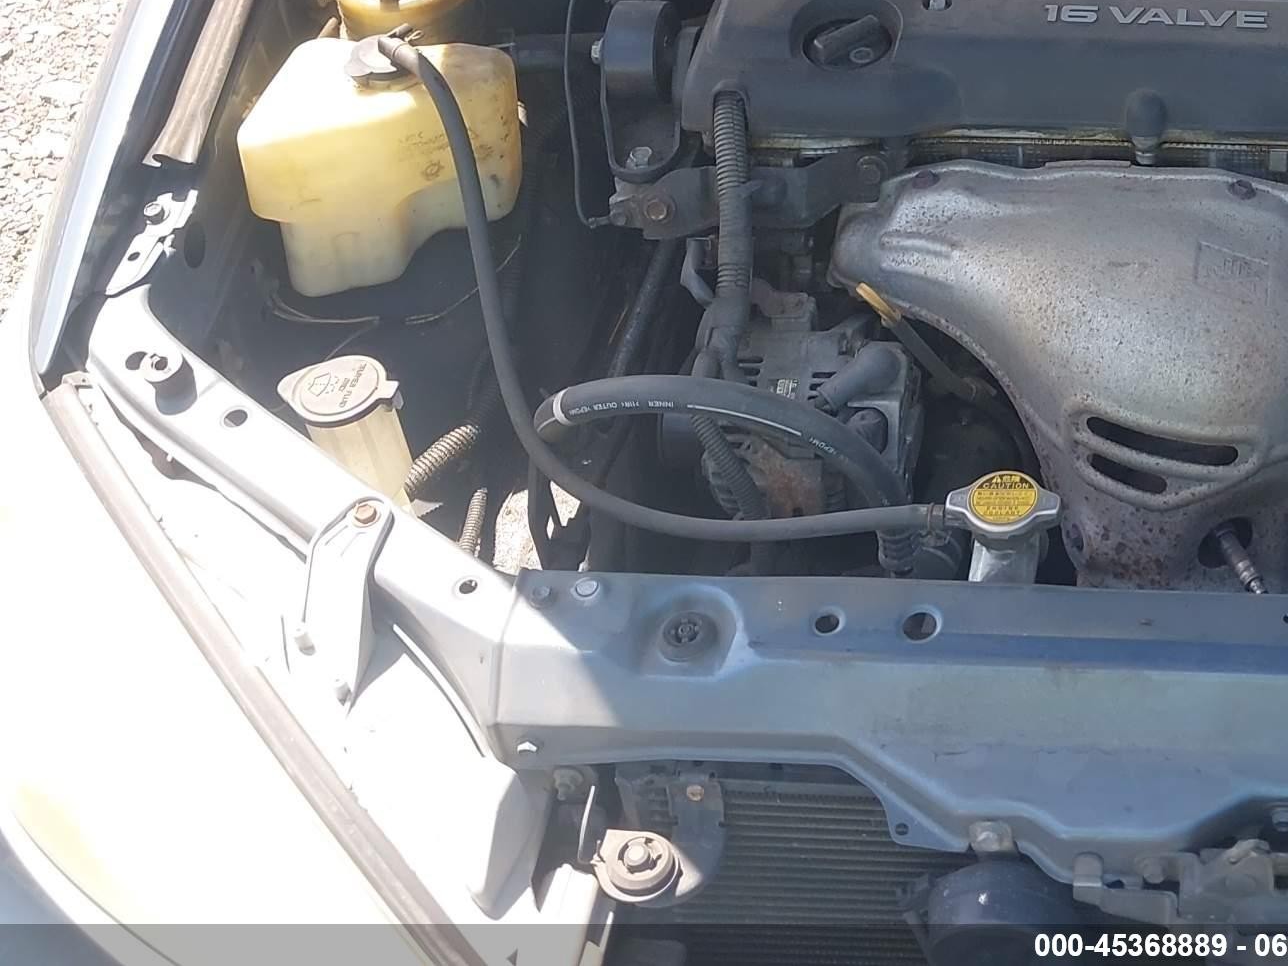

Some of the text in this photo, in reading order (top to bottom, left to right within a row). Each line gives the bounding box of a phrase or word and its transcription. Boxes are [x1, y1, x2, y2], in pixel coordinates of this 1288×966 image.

[1045, 3, 1269, 29] 16 VALVE
[592, 401, 618, 411] OUTER
[648, 400, 674, 408] INNER
[983, 482, 1029, 490] CAUTION
